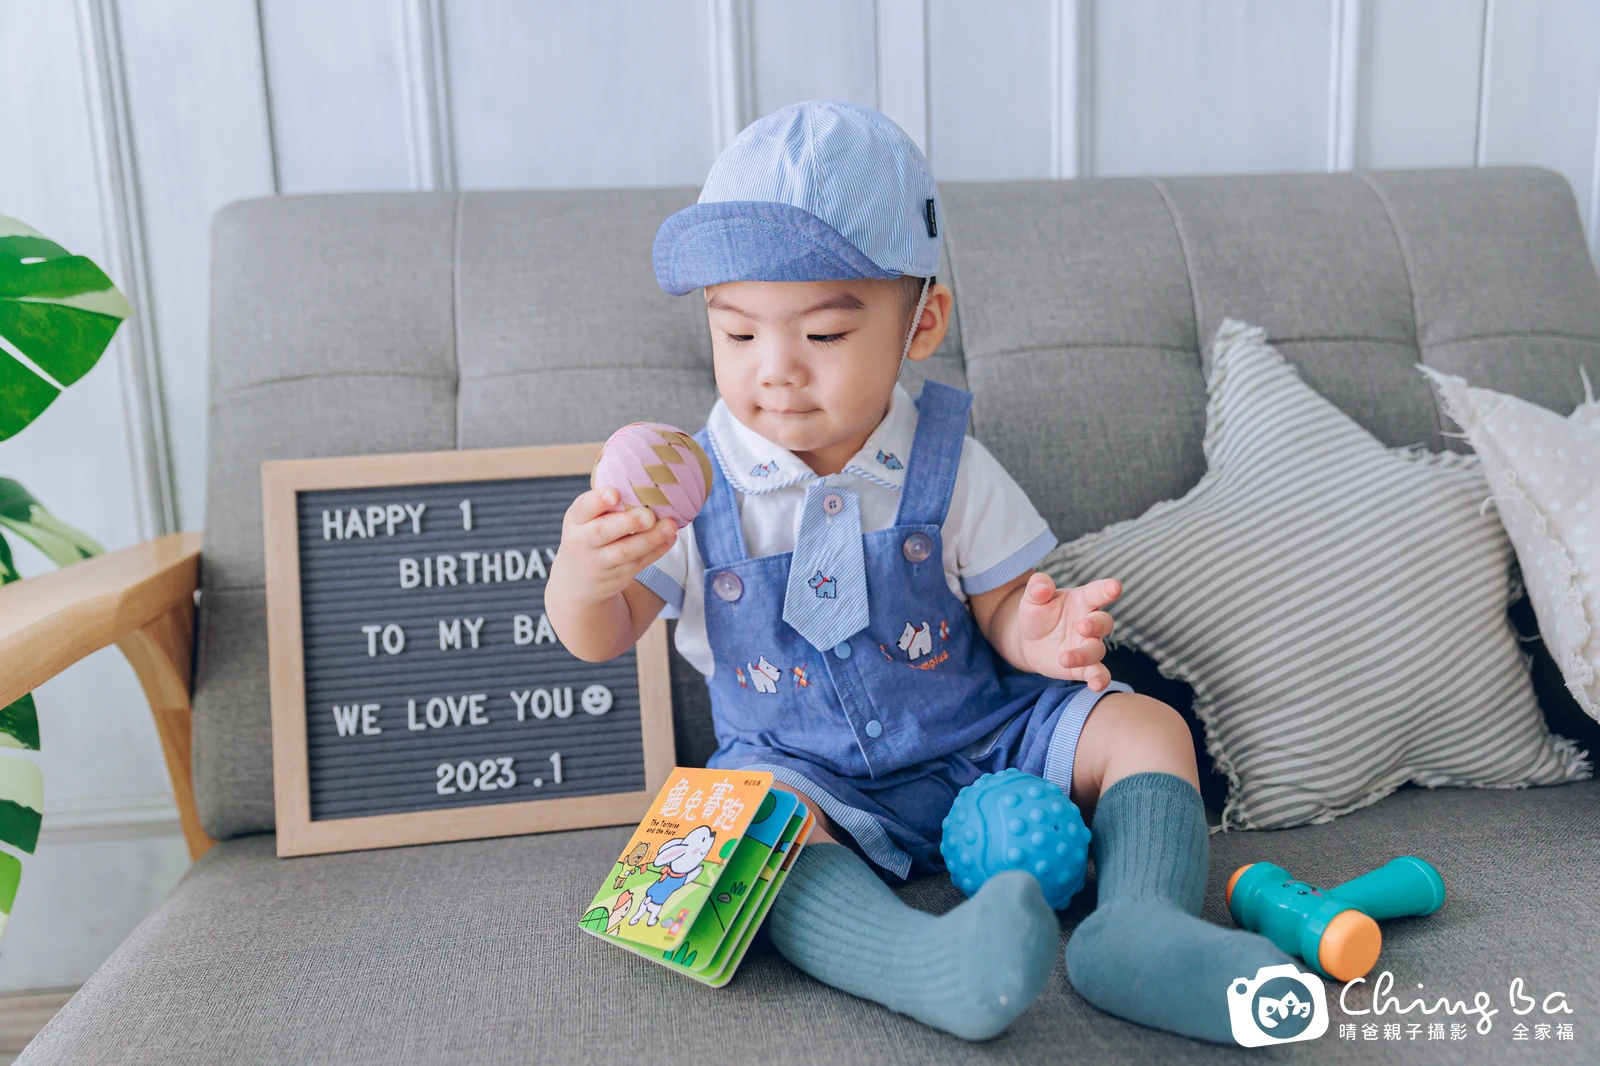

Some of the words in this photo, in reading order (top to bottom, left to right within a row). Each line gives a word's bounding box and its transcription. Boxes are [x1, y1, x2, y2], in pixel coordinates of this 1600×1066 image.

[321, 502, 426, 541] HAPPY
[459, 498, 473, 532] 1
[361, 624, 405, 658] TO
[438, 617, 485, 651] MY
[513, 612, 558, 646] BA
[332, 703, 382, 737] WE
[407, 693, 489, 732] LOVE
[509, 686, 573, 722] YOU
[435, 756, 517, 795] 2023
[651, 819, 660, 827] The
[660, 820, 680, 829] Tortoise
[659, 777, 745, 831] 龜兔賽跑
